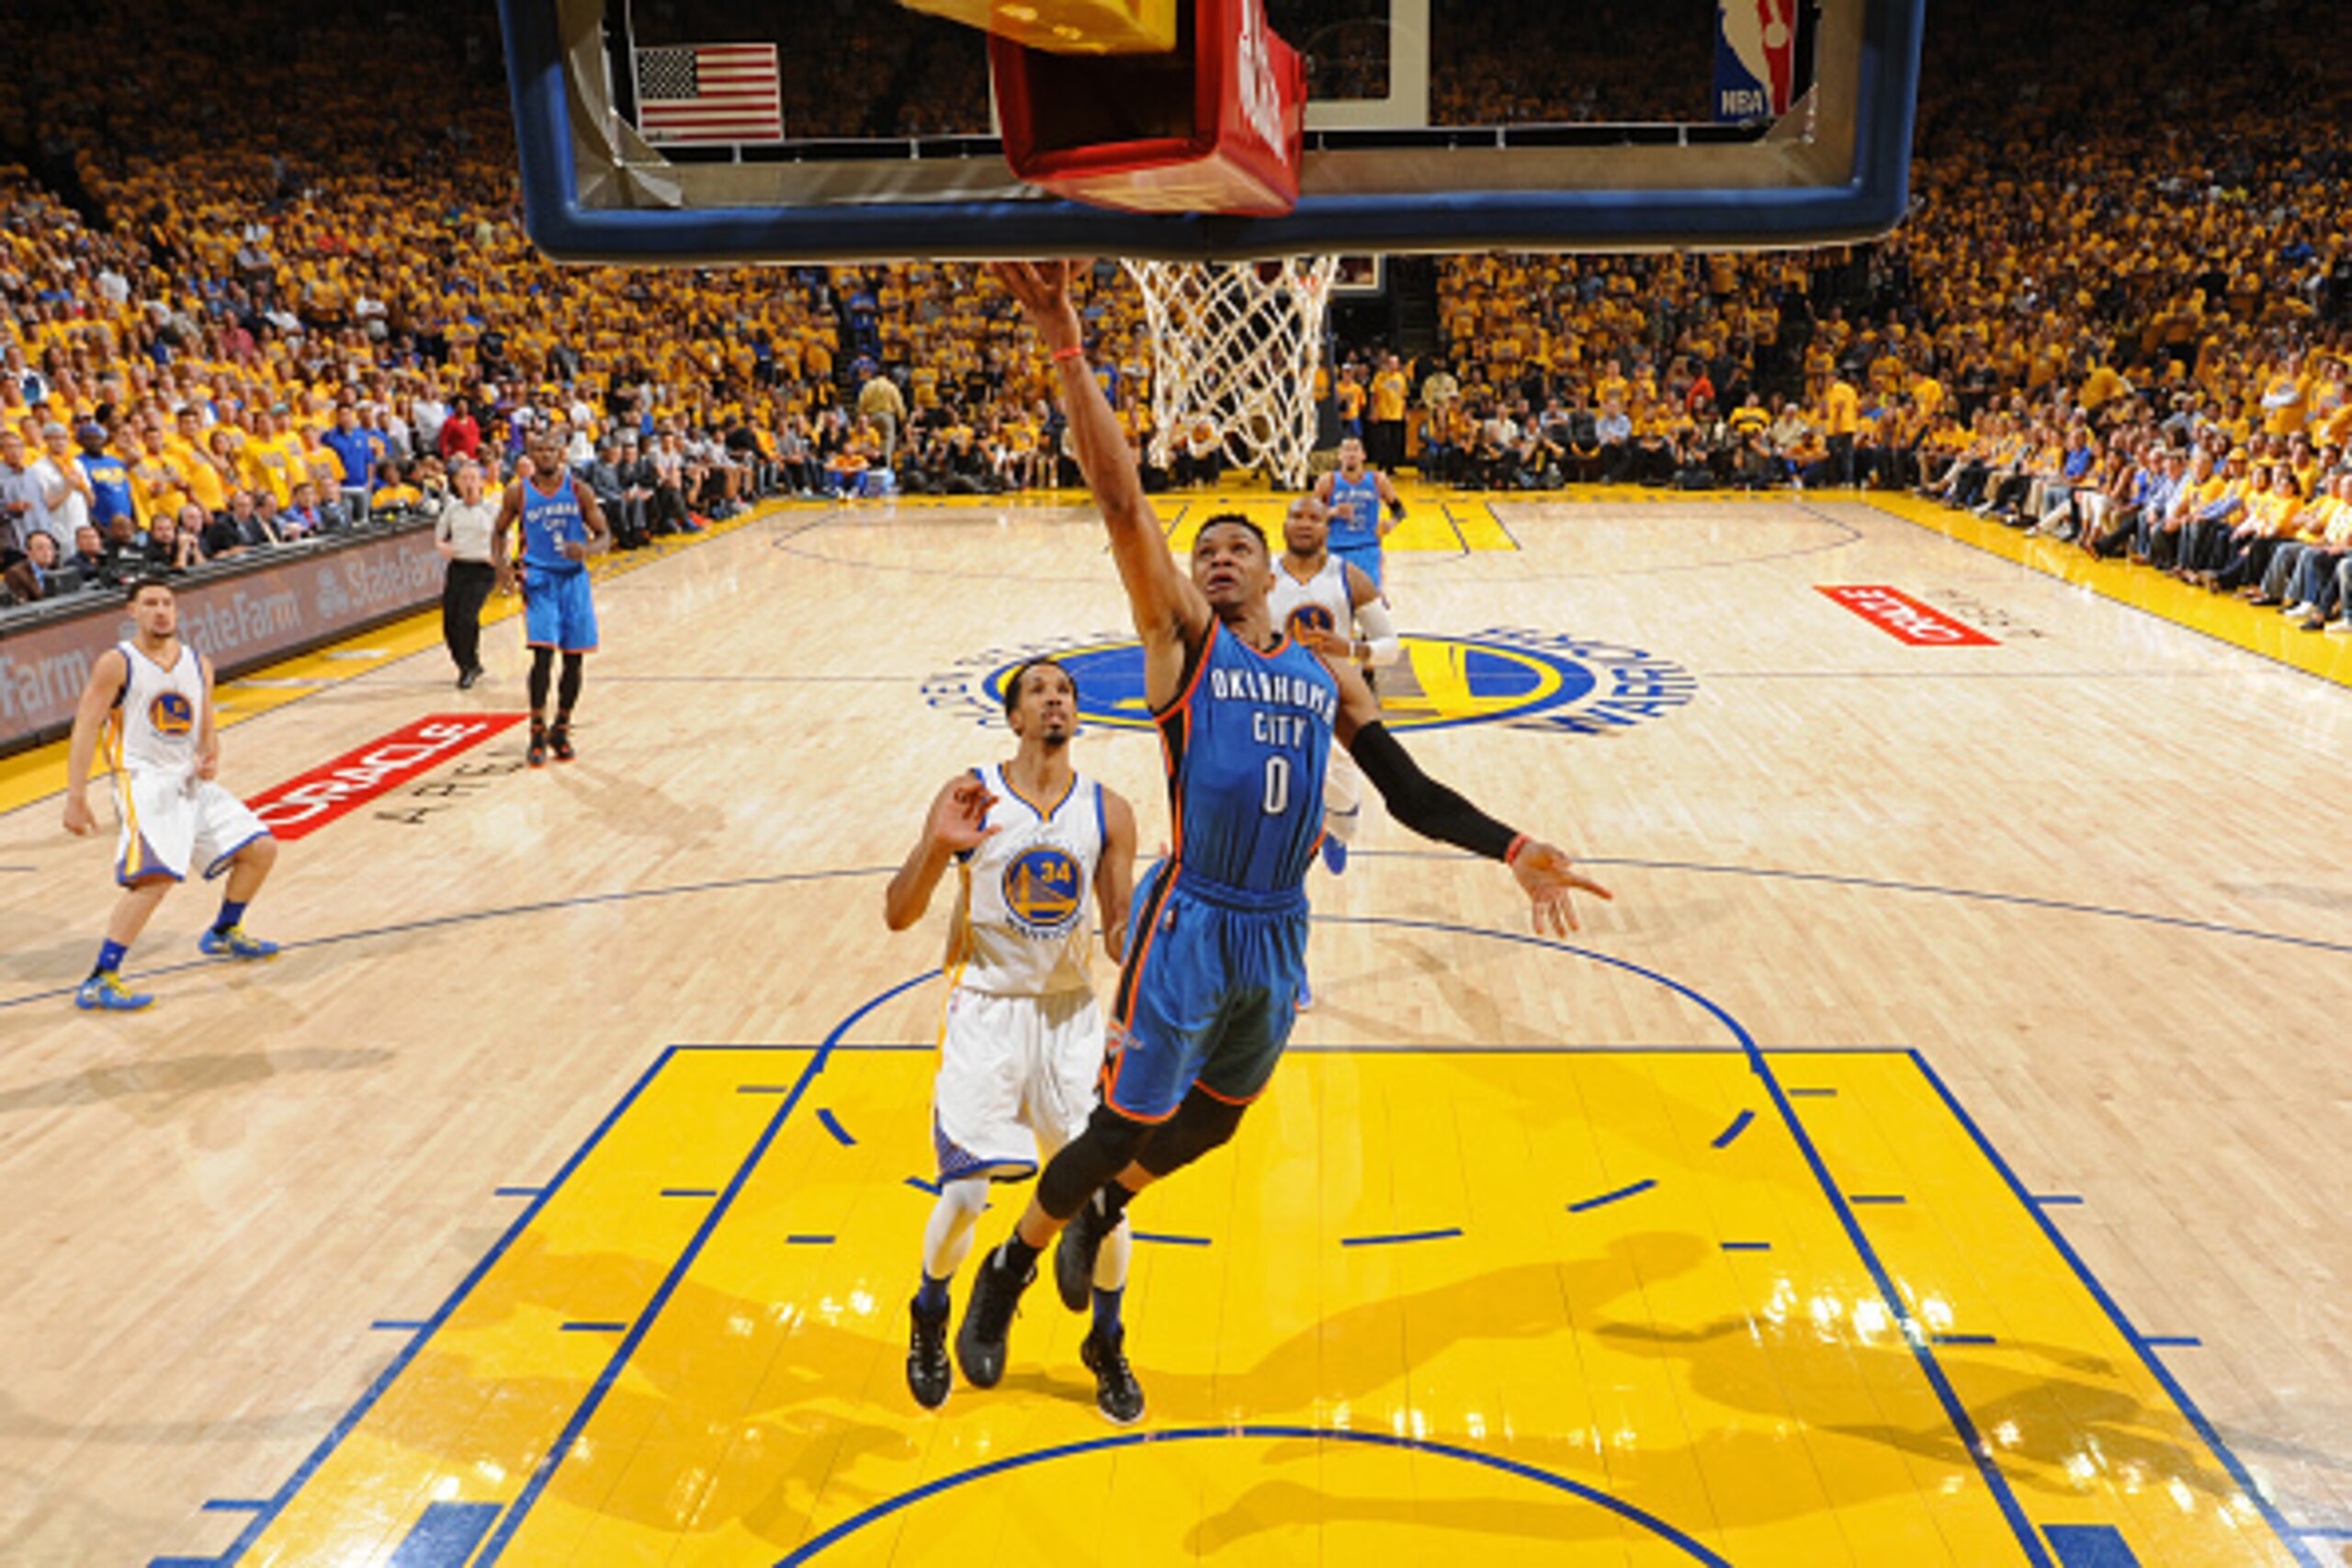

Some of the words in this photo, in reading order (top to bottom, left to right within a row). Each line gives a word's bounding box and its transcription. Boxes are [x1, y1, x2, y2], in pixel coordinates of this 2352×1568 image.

[1721, 89, 1764, 116] NBA
[1210, 667, 1338, 727] OKLAHOMA
[1252, 711, 1307, 750] CITY
[254, 722, 489, 826] ORACLE
[1262, 755, 1291, 816] 0
[1040, 861, 1073, 884] 34
